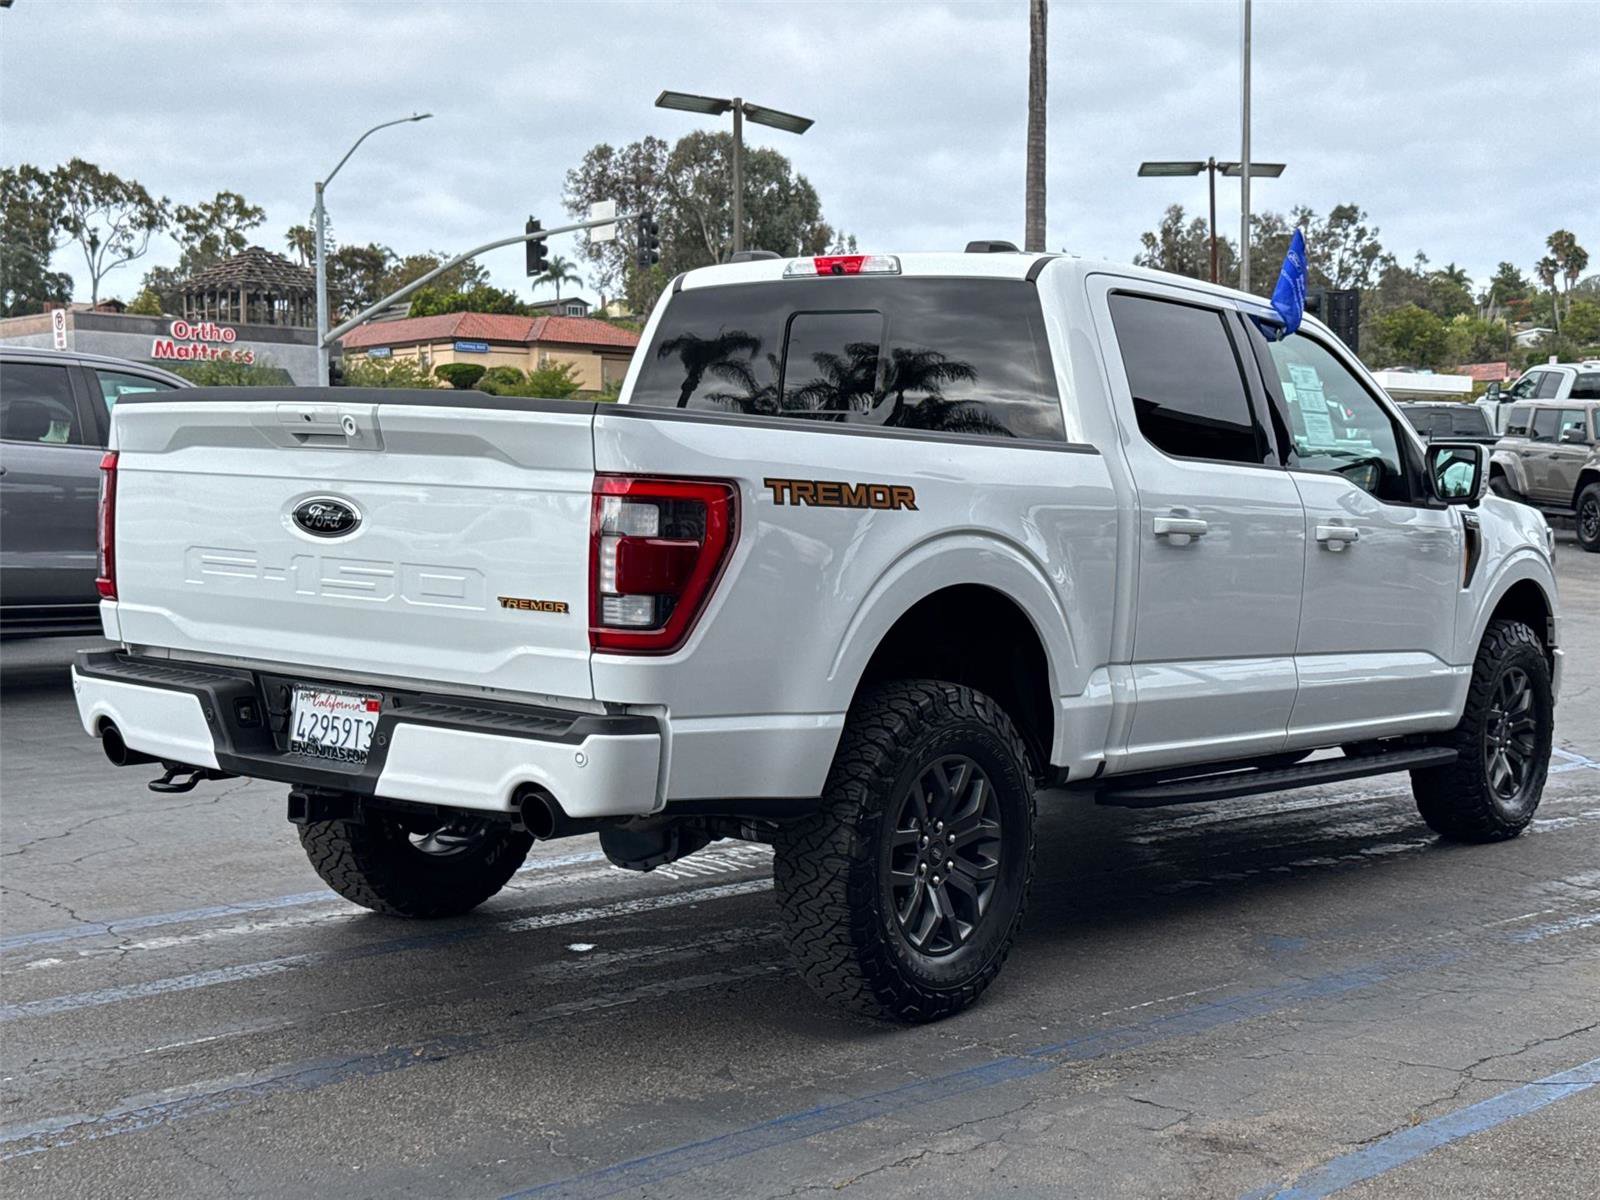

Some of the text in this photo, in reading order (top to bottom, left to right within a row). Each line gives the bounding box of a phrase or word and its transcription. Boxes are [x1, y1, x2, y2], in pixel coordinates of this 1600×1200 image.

[171, 321, 237, 341] Ortho
[152, 338, 255, 364] Mattress
[763, 478, 919, 511] TREMOR
[305, 504, 342, 528] Ford
[185, 546, 486, 610] F-150
[498, 597, 569, 615] TREMOR
[313, 693, 361, 713] California
[296, 711, 374, 749] 42959T3
[291, 741, 346, 759] ENCINITAS
